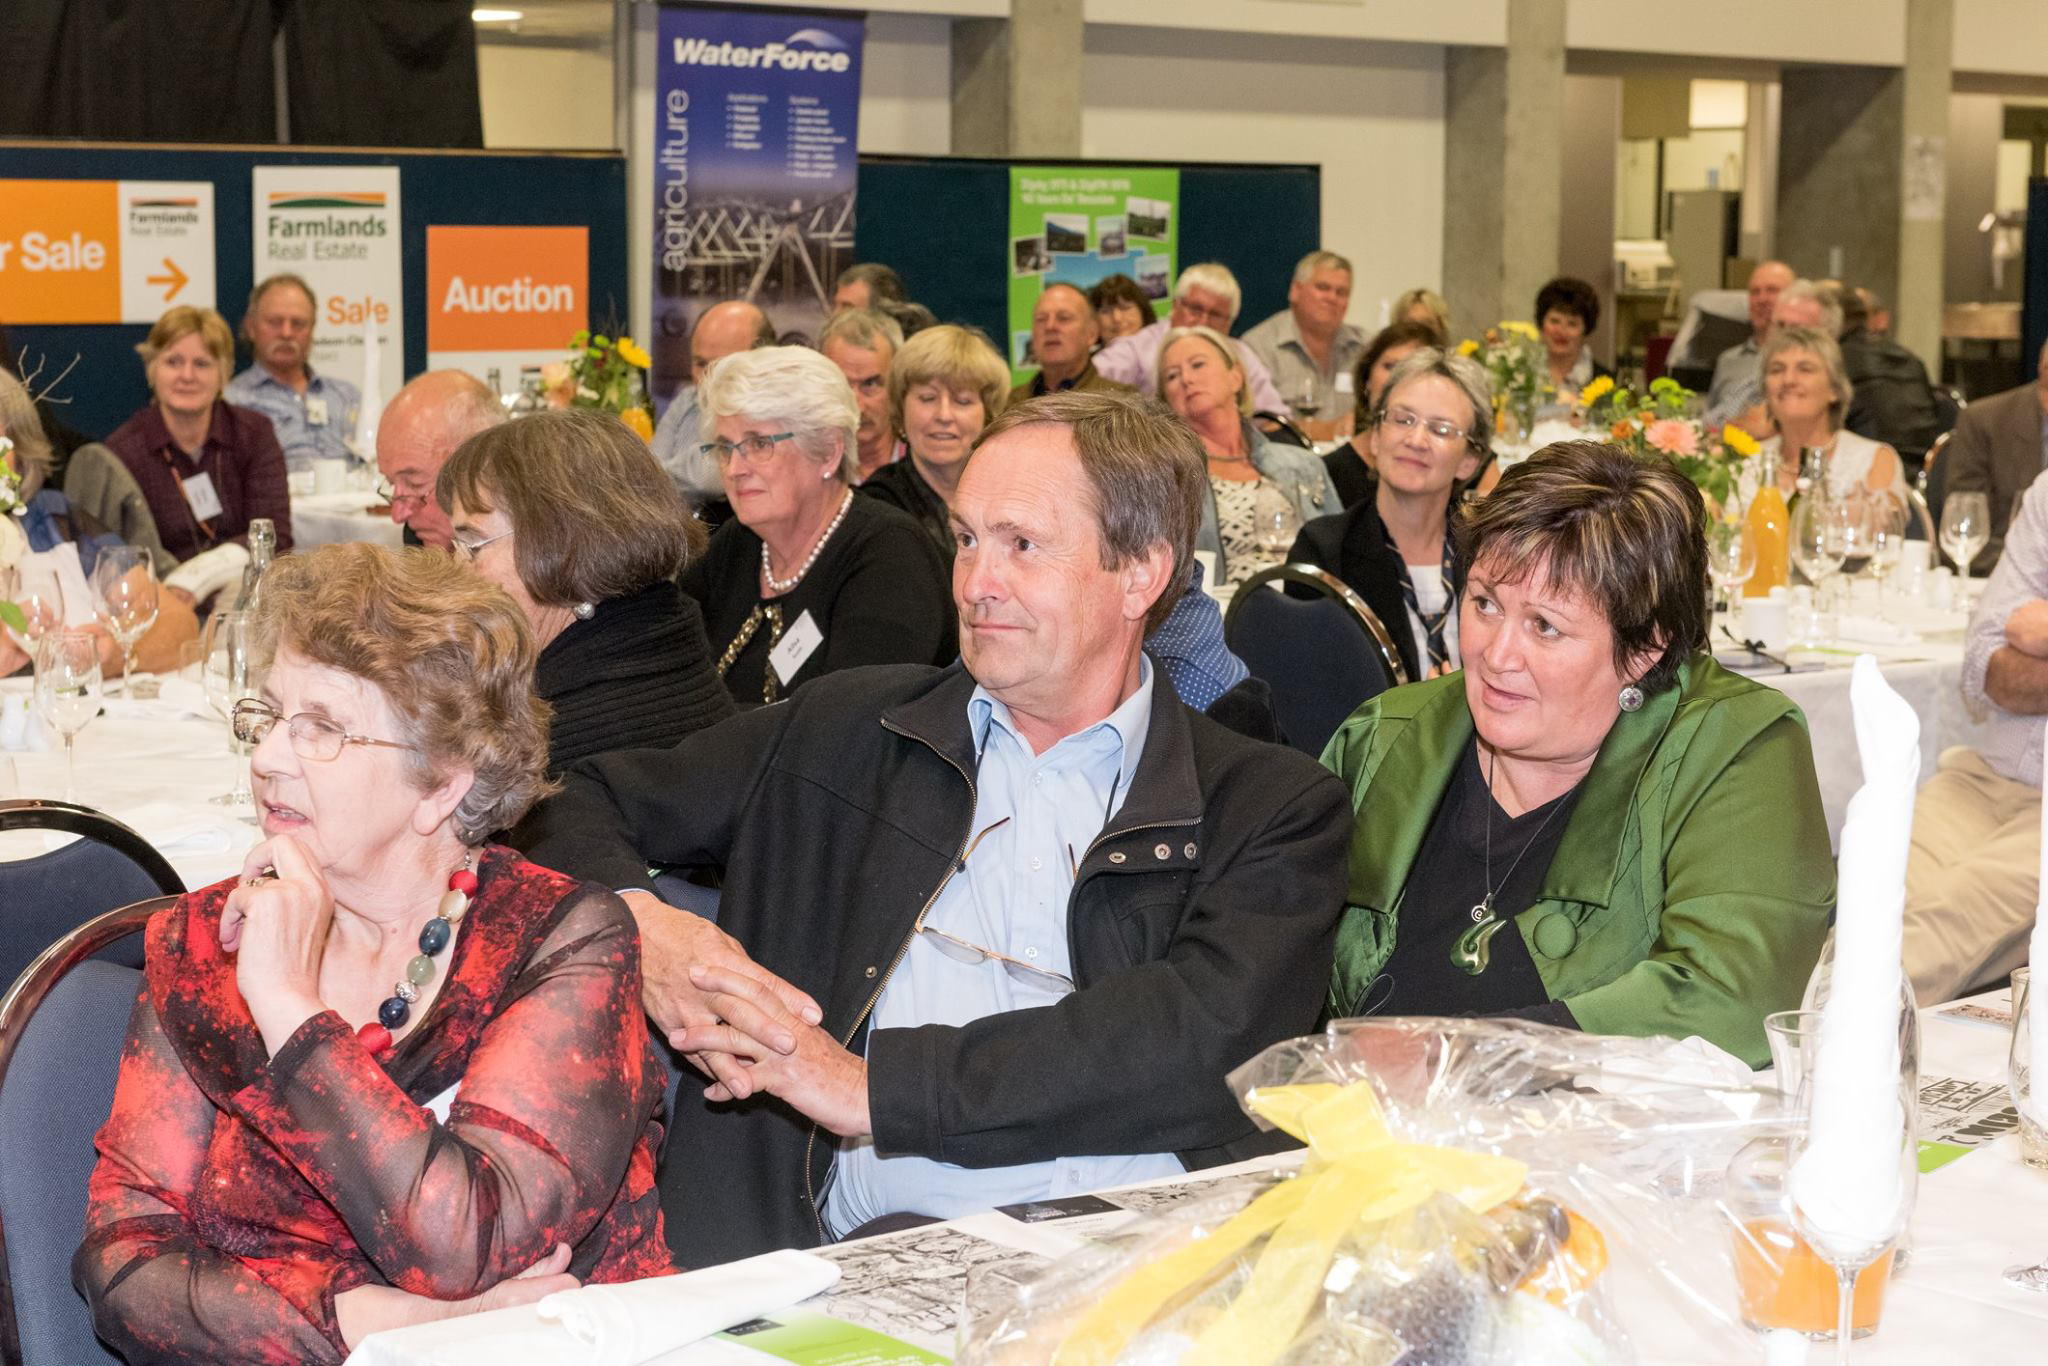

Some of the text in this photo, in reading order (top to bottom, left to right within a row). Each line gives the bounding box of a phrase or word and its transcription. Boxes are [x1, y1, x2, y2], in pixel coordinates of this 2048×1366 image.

[673, 37, 850, 73] WaterForce
[659, 88, 690, 272] agriculture
[129, 211, 199, 225] Farmlands
[267, 215, 387, 239] Farmlands
[20, 230, 106, 272] Sale
[267, 240, 369, 262] Real Estate
[326, 294, 390, 326] Sale
[442, 276, 575, 314] Auction
